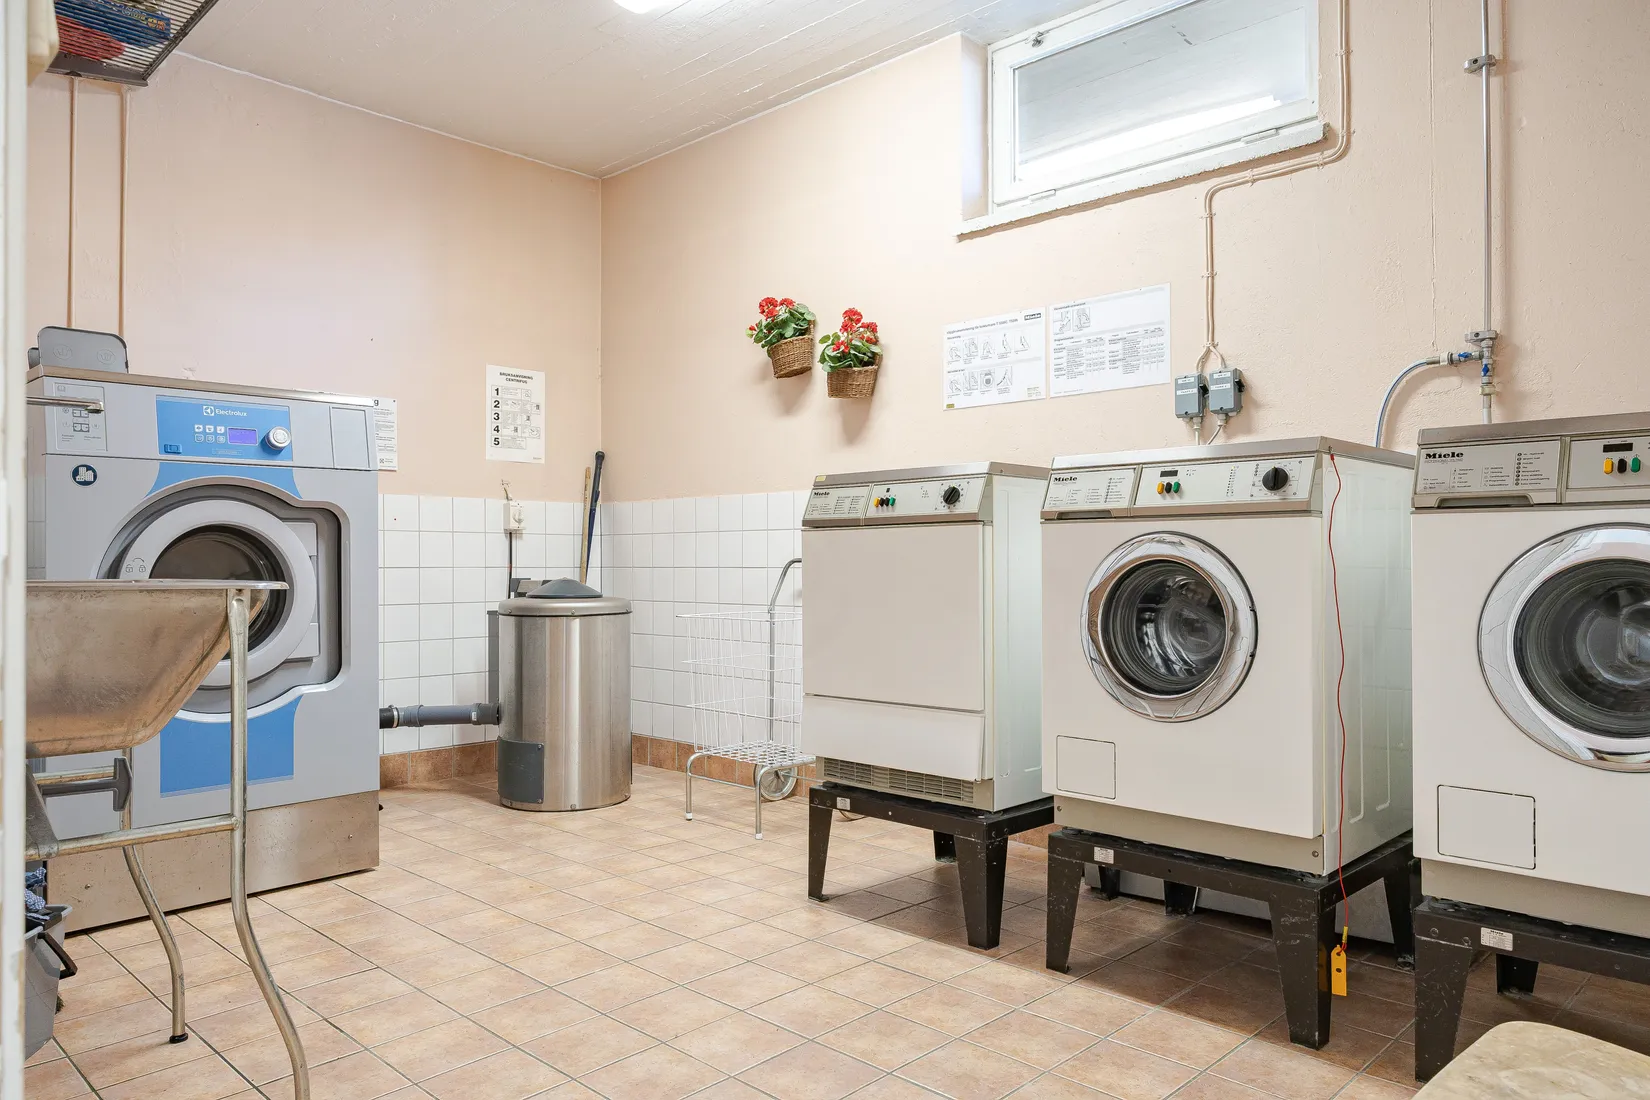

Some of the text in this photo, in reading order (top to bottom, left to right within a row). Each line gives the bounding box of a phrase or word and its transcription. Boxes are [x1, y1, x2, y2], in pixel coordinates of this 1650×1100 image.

[499, 372, 533, 380] BRUKSANVISNING
[494, 388, 499, 396] 1
[493, 400, 500, 408] 2
[215, 408, 247, 417] Electrolux
[493, 412, 500, 421] 3
[493, 425, 500, 433] 4
[493, 437, 500, 446] 5
